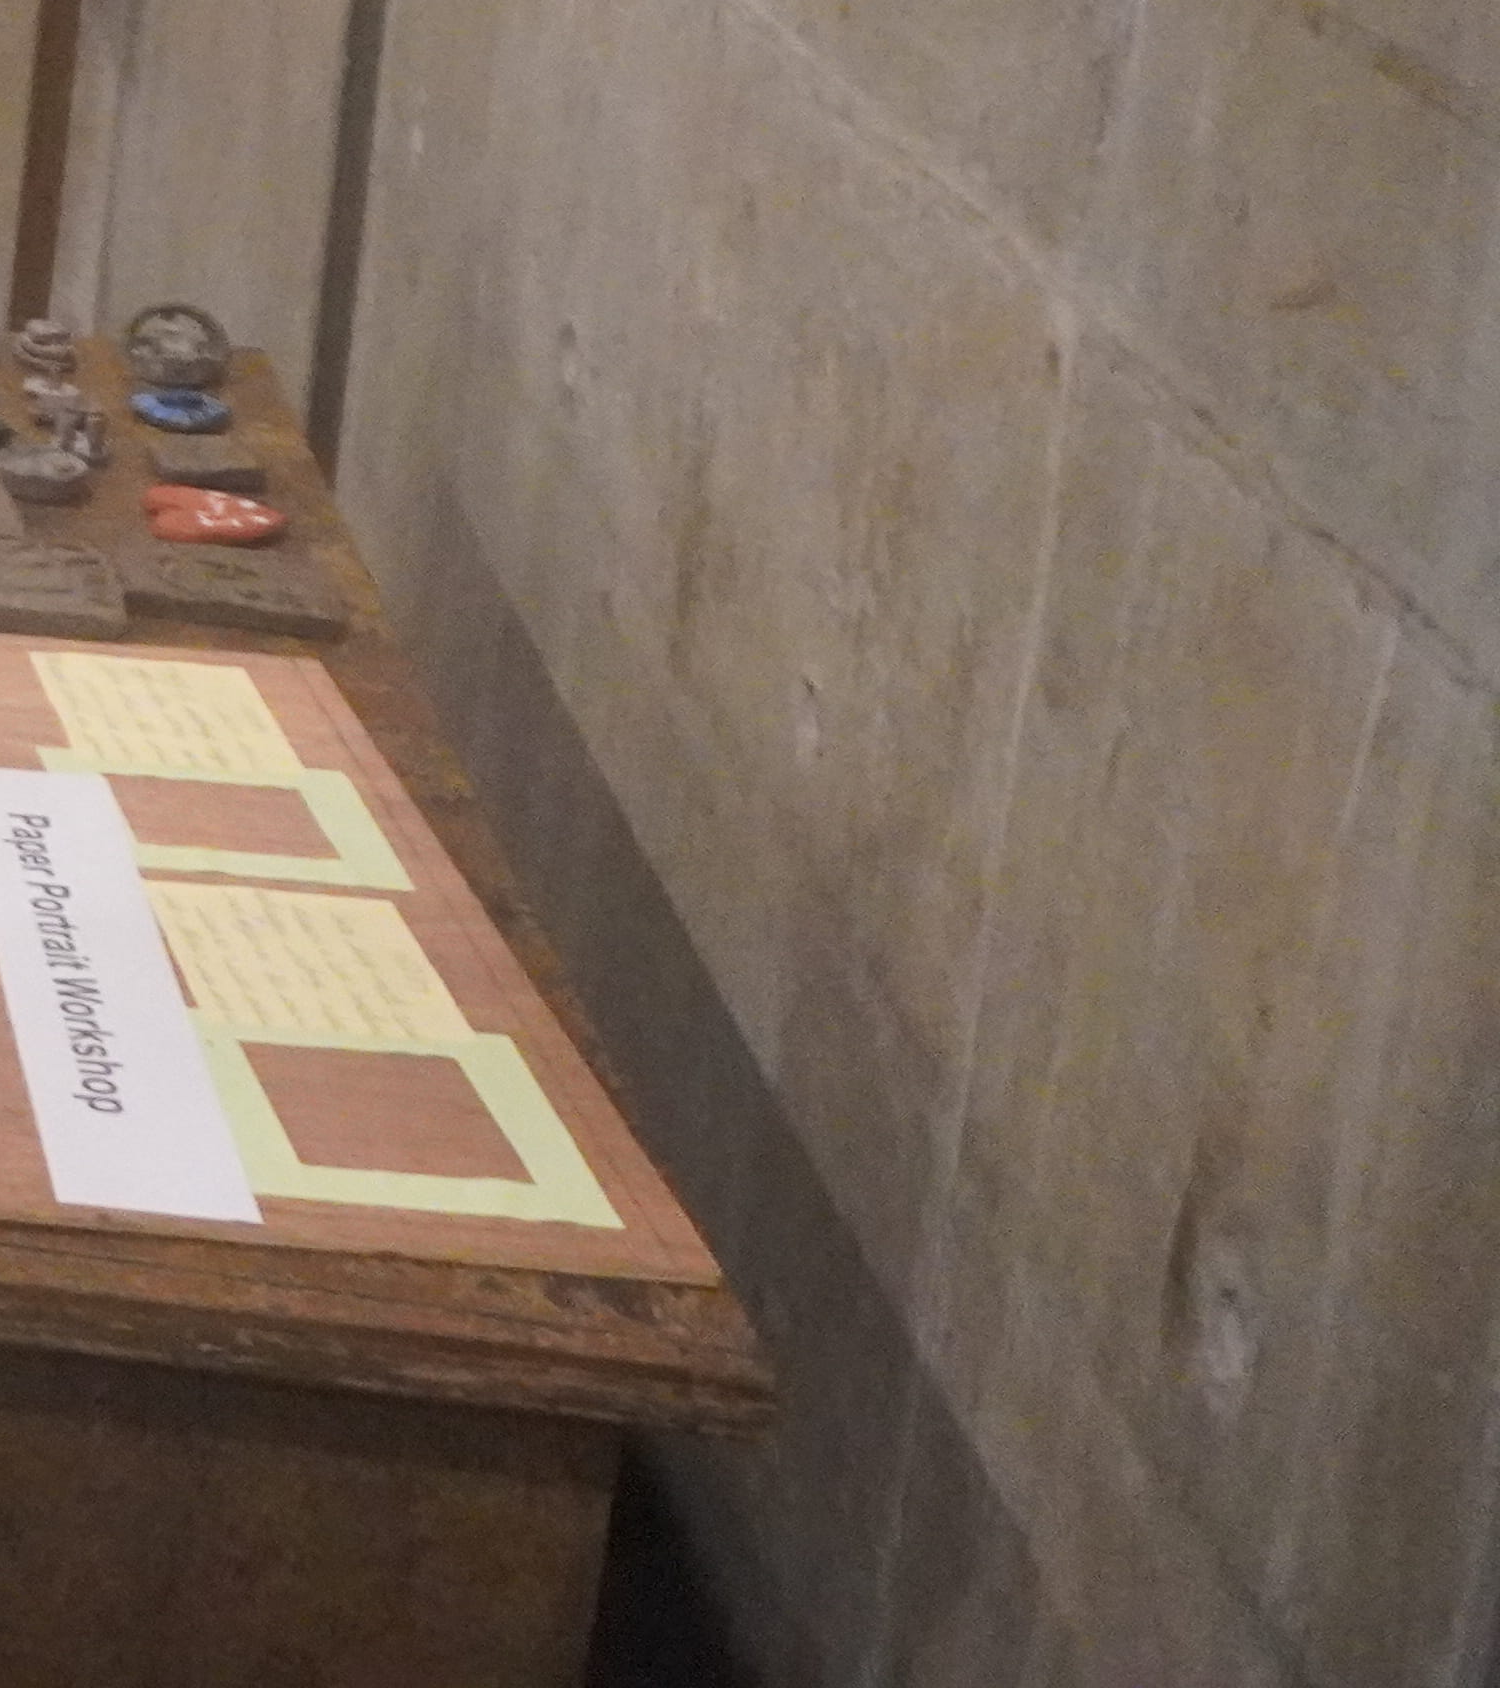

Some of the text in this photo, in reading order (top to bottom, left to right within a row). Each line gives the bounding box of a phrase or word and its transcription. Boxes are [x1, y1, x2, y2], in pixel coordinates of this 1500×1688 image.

[3, 812, 123, 1114] Paper Portrait Workshop
